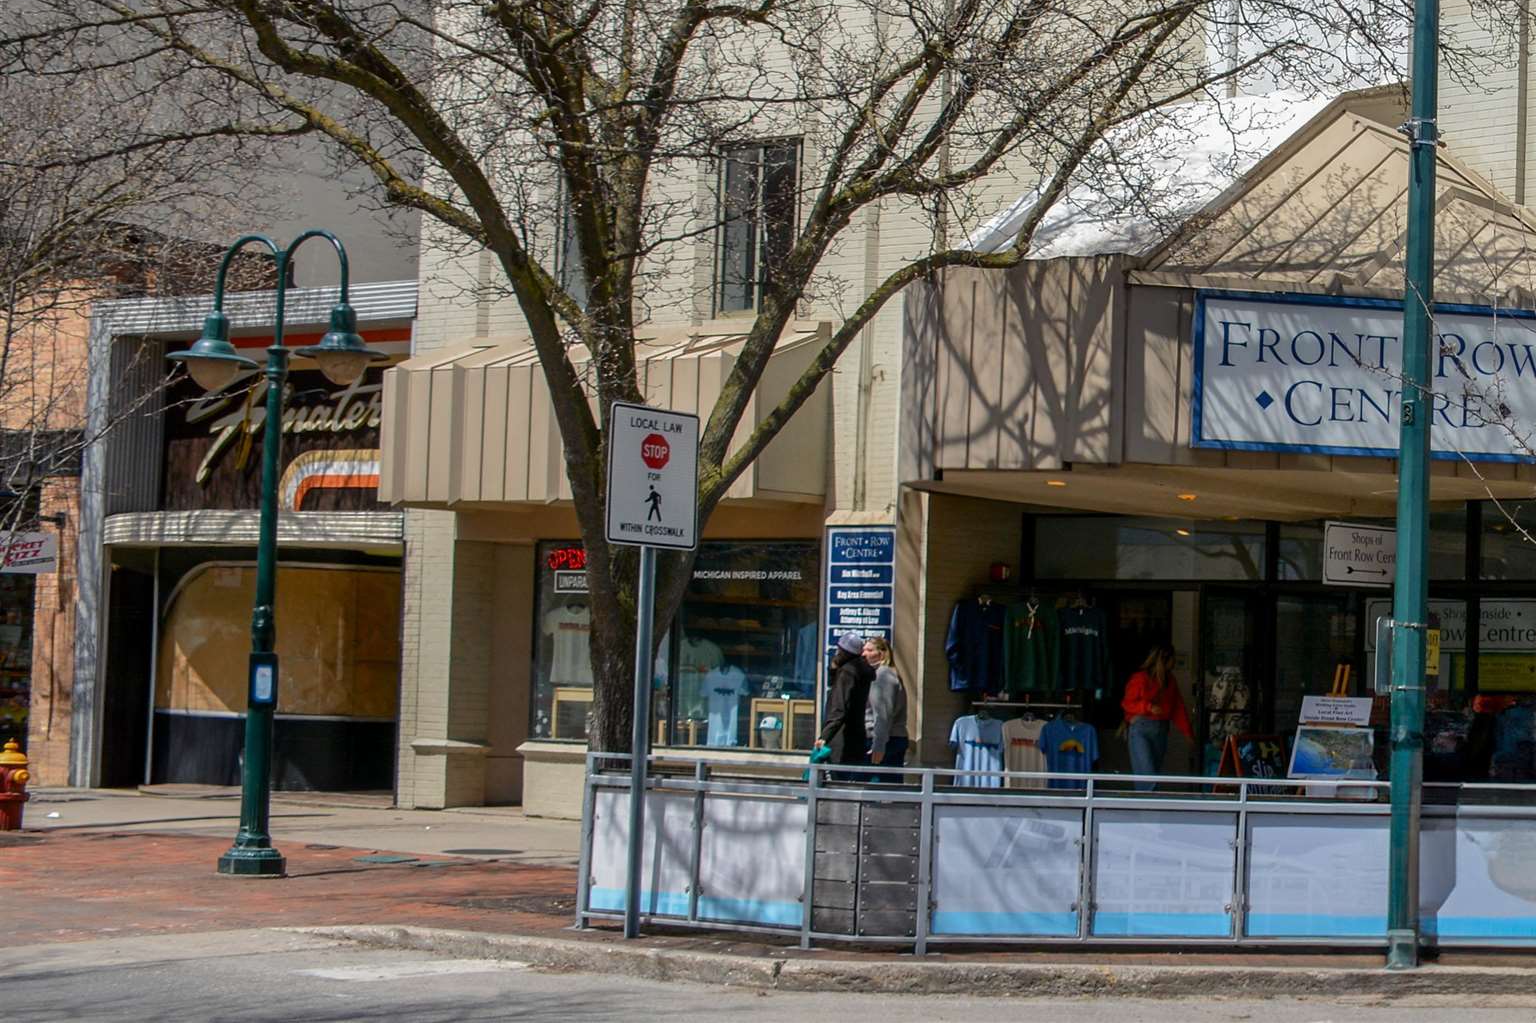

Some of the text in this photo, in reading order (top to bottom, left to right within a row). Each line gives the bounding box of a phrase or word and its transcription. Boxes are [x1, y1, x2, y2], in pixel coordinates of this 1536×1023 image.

[1218, 321, 1398, 368] FRONT
[630, 416, 683, 434] LOCAL LAW
[643, 444, 668, 459] STOP
[648, 472, 661, 481] FOR
[620, 522, 684, 537] WITHIN CROSSWALK
[835, 536, 890, 547] FRONT ROW
[1352, 532, 1383, 547] Shops of
[845, 548, 878, 558] CENTRE
[1329, 546, 1352, 560] Front
[1354, 548, 1374, 562] Row
[693, 570, 802, 580] MICHIGAN INSPIRED APPAREL
[1480, 607, 1511, 619] nside
[1439, 629, 1466, 642] ow
